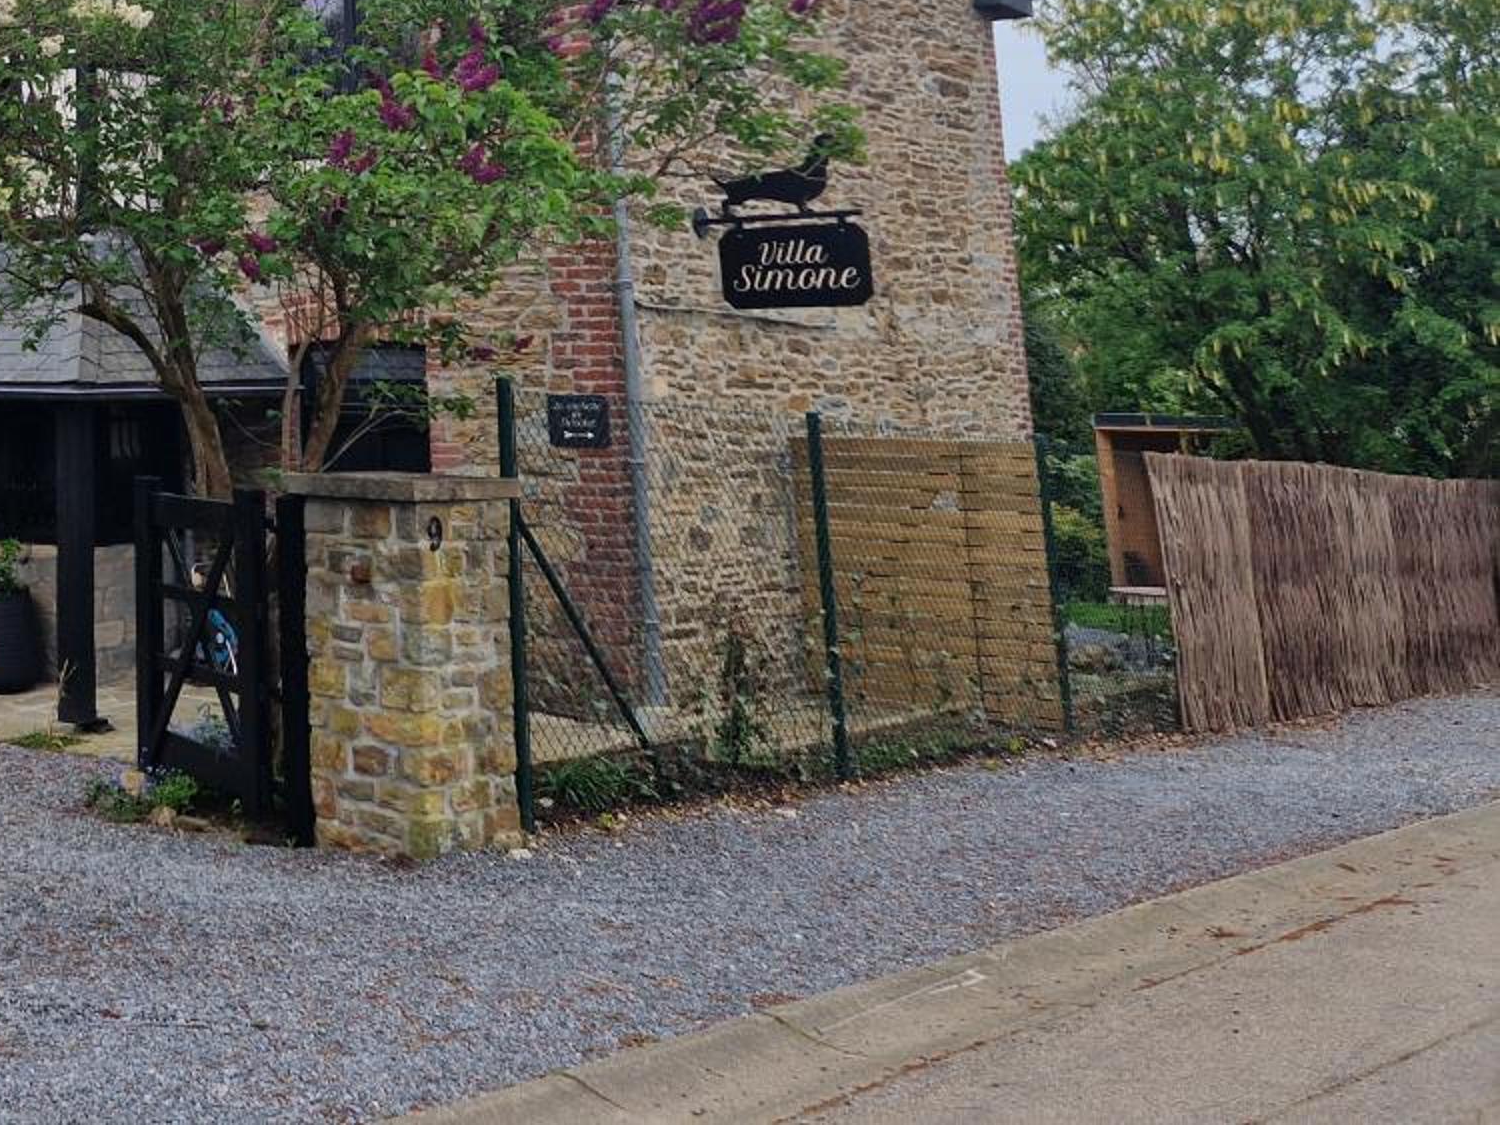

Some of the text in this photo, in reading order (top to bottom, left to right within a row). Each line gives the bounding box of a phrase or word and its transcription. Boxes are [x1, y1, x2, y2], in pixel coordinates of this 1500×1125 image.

[758, 239, 828, 265] Villa
[733, 264, 860, 291] Simone
[427, 516, 442, 552] 9
